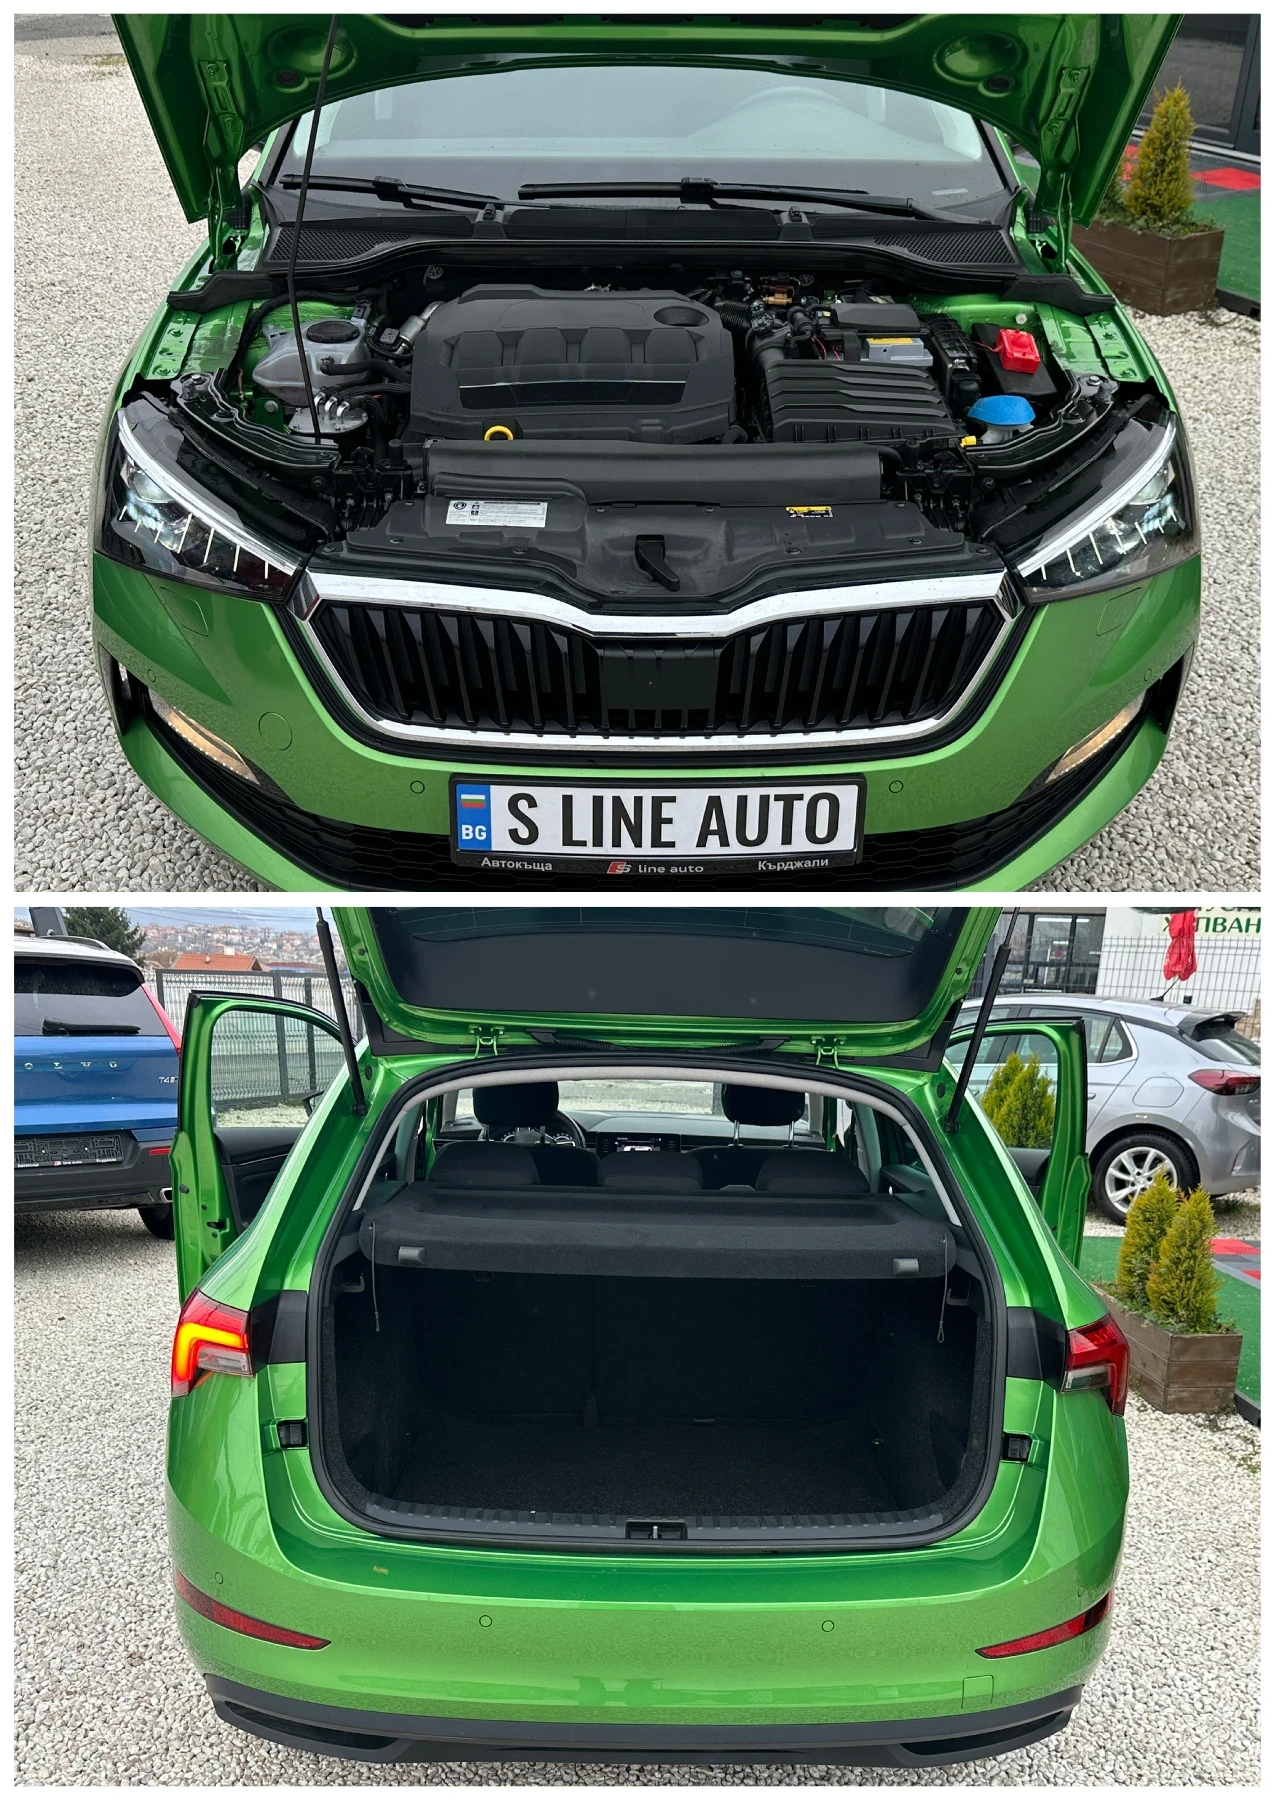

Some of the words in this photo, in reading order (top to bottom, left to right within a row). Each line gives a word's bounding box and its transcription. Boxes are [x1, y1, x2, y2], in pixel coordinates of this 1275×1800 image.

[508, 793, 539, 845] S
[562, 795, 676, 848] LINE
[696, 792, 840, 847] AUTO
[461, 825, 487, 840] BG
[481, 857, 552, 871] Автокъща
[638, 864, 666, 873] line
[669, 864, 704, 873] auto
[757, 858, 829, 871] Кърджали
[1163, 916, 1261, 933] ХПВАН
[24, 1061, 118, 1070] OLVO
